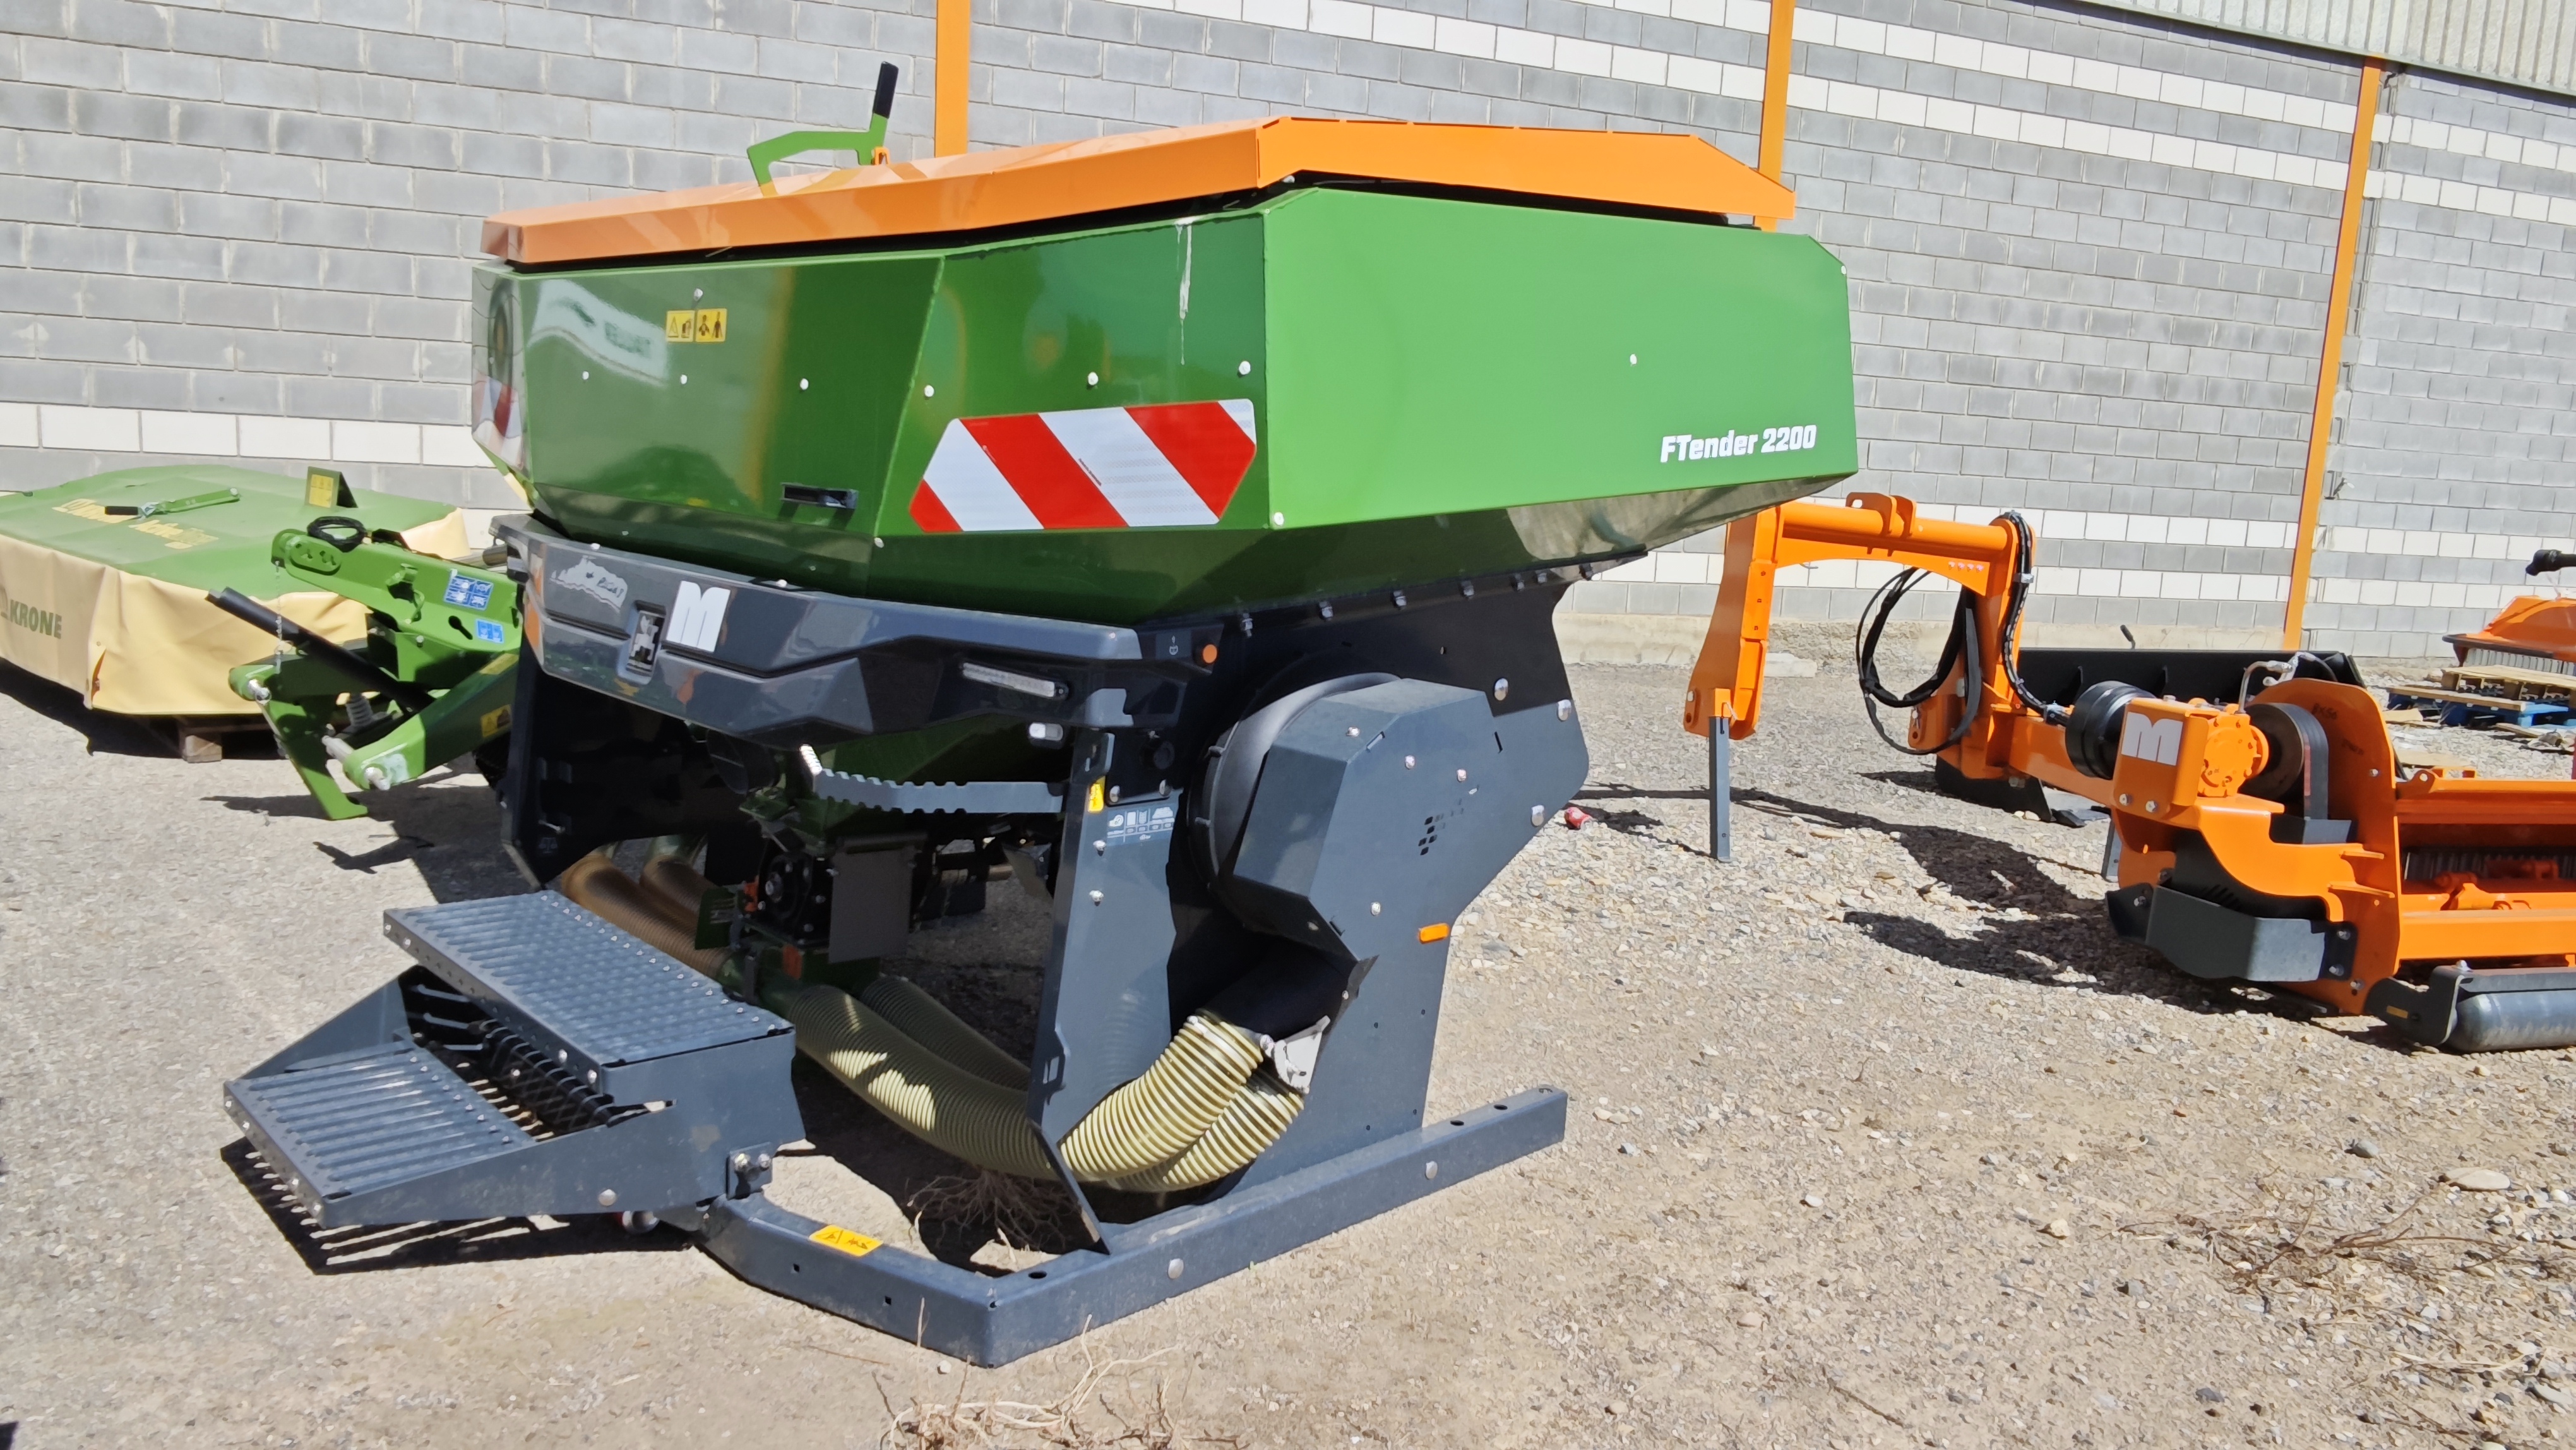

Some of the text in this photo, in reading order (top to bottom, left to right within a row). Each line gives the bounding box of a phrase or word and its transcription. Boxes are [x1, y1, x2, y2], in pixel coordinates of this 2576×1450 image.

[1660, 424, 1817, 463] FTender 2200
[10, 599, 62, 639] KRONE
